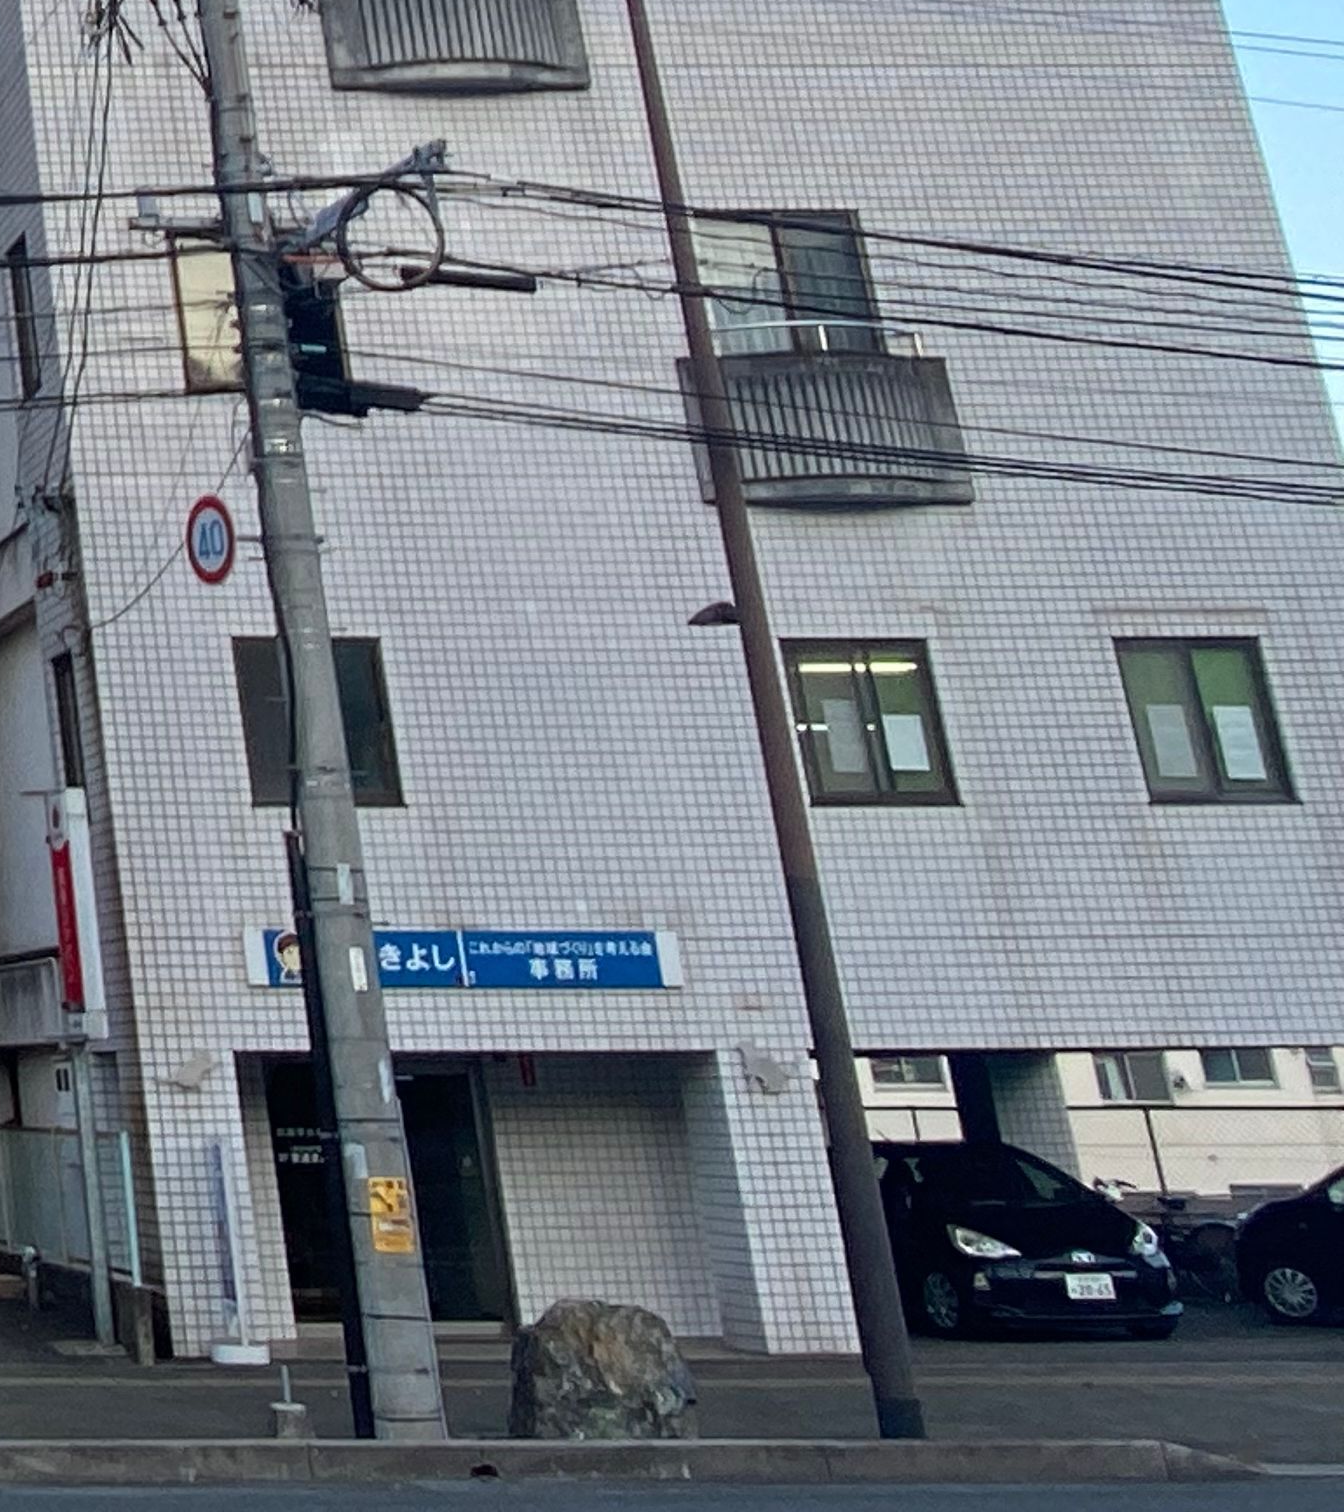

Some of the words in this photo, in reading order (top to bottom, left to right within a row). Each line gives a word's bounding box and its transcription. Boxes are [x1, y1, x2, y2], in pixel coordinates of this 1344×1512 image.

[199, 519, 224, 559] 40
[379, 941, 456, 972] きよし
[529, 958, 599, 981] 事務所
